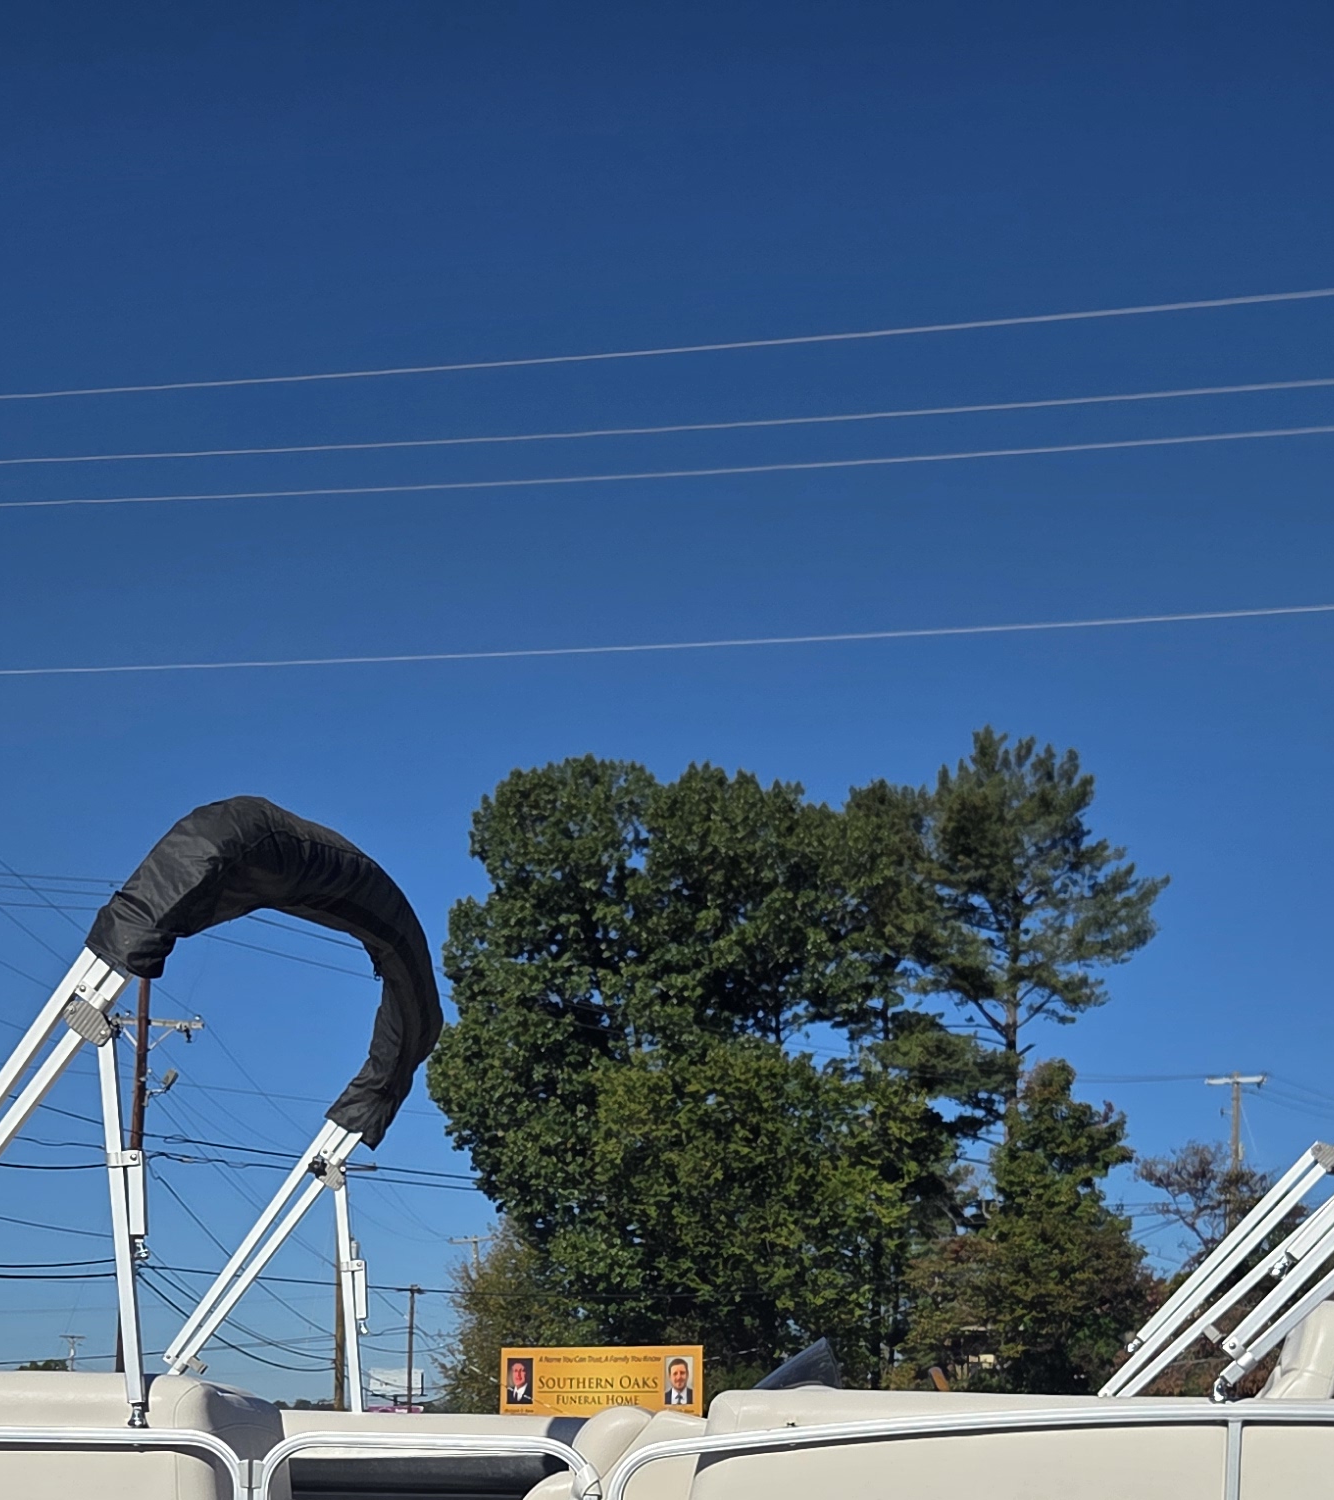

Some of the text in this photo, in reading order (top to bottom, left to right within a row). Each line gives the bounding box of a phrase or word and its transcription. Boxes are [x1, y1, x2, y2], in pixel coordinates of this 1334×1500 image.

[537, 1374, 659, 1390] SOUTHERN OAKS
[555, 1394, 640, 1406] FUNERAL HOME
